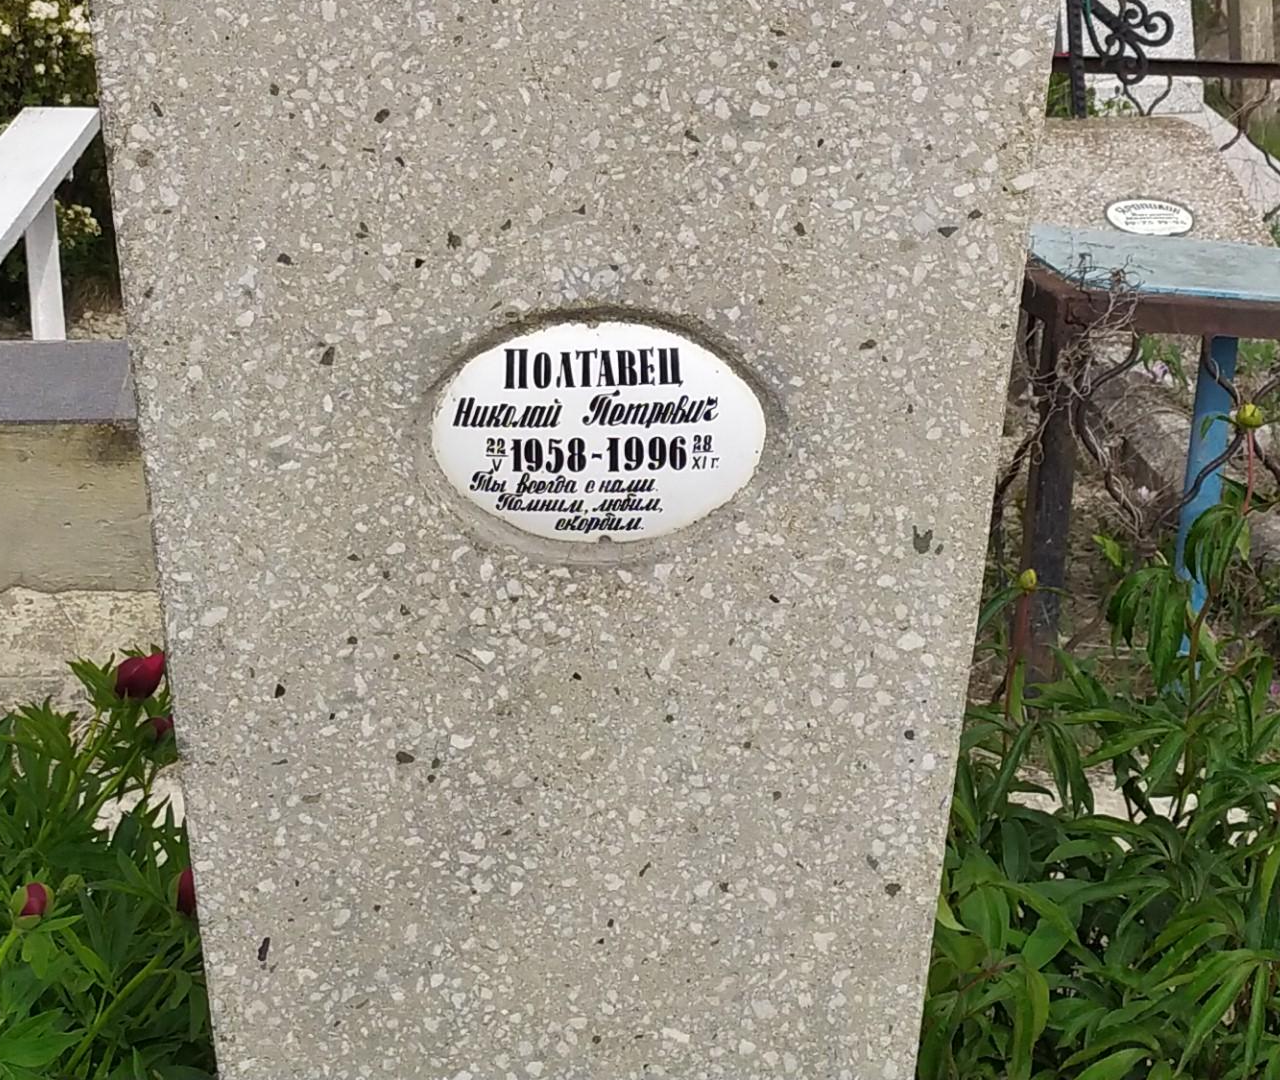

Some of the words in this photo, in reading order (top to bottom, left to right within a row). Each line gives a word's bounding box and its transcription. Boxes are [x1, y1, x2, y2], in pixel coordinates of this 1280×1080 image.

[504, 348, 683, 389] ПОЛТАВЕЦ
[452, 397, 563, 428] Николай
[582, 390, 719, 428] Петрович
[470, 471, 507, 492] Ты
[516, 472, 578, 493] всегда
[584, 479, 595, 493] с
[495, 492, 589, 514] Помним,
[592, 493, 664, 512] любим,
[554, 512, 645, 533] скорбим.
